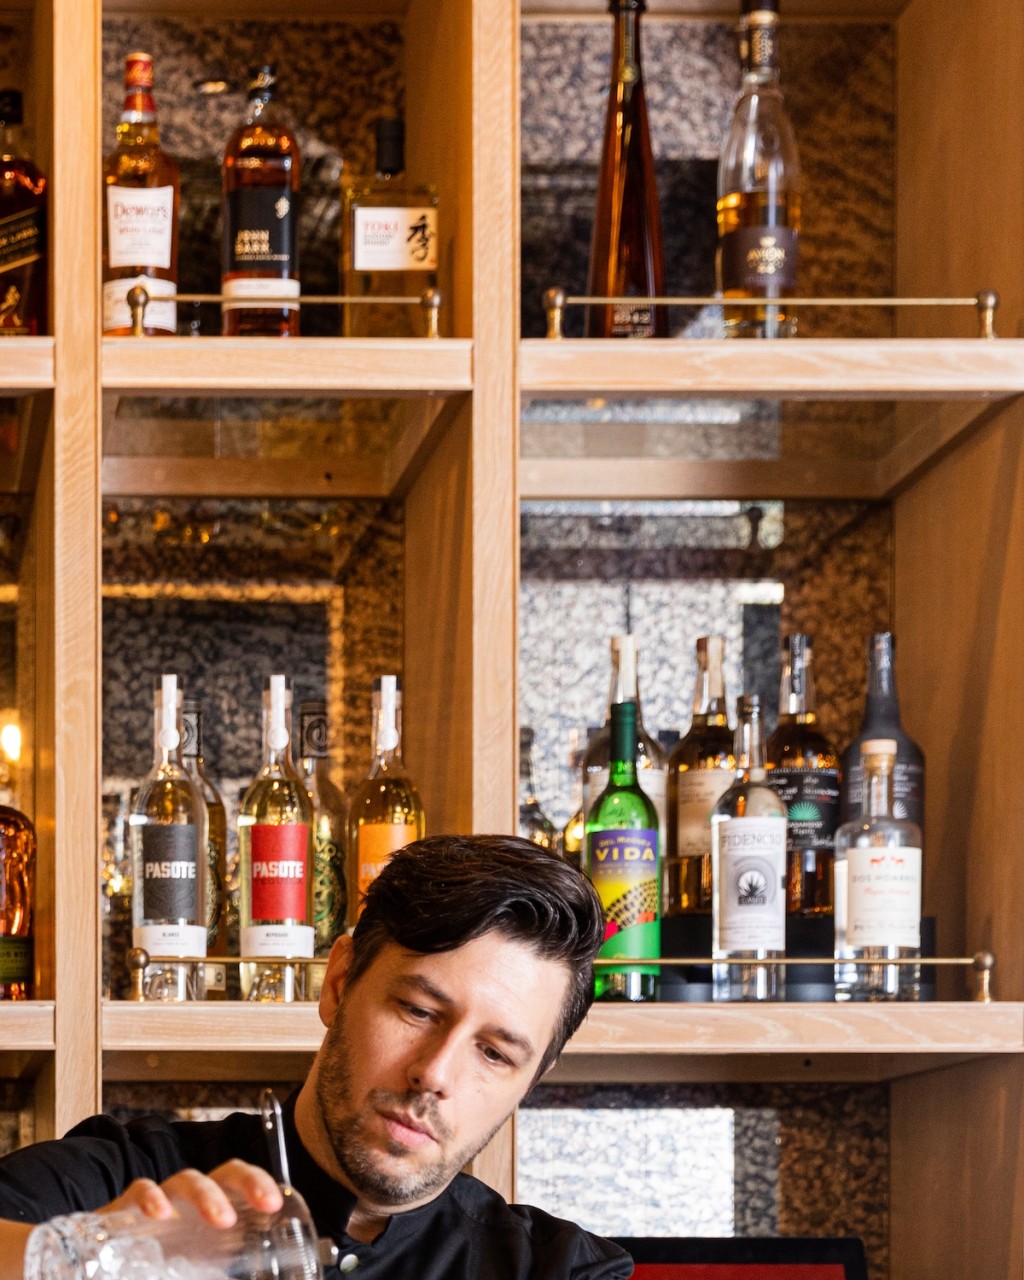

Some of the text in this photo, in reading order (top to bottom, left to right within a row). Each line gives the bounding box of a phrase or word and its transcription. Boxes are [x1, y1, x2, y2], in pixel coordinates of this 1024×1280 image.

[237, 229, 270, 241] JOHN
[595, 847, 655, 861] VIDA
[145, 861, 196, 879] PASOTE
[253, 861, 304, 879] PASOTE
